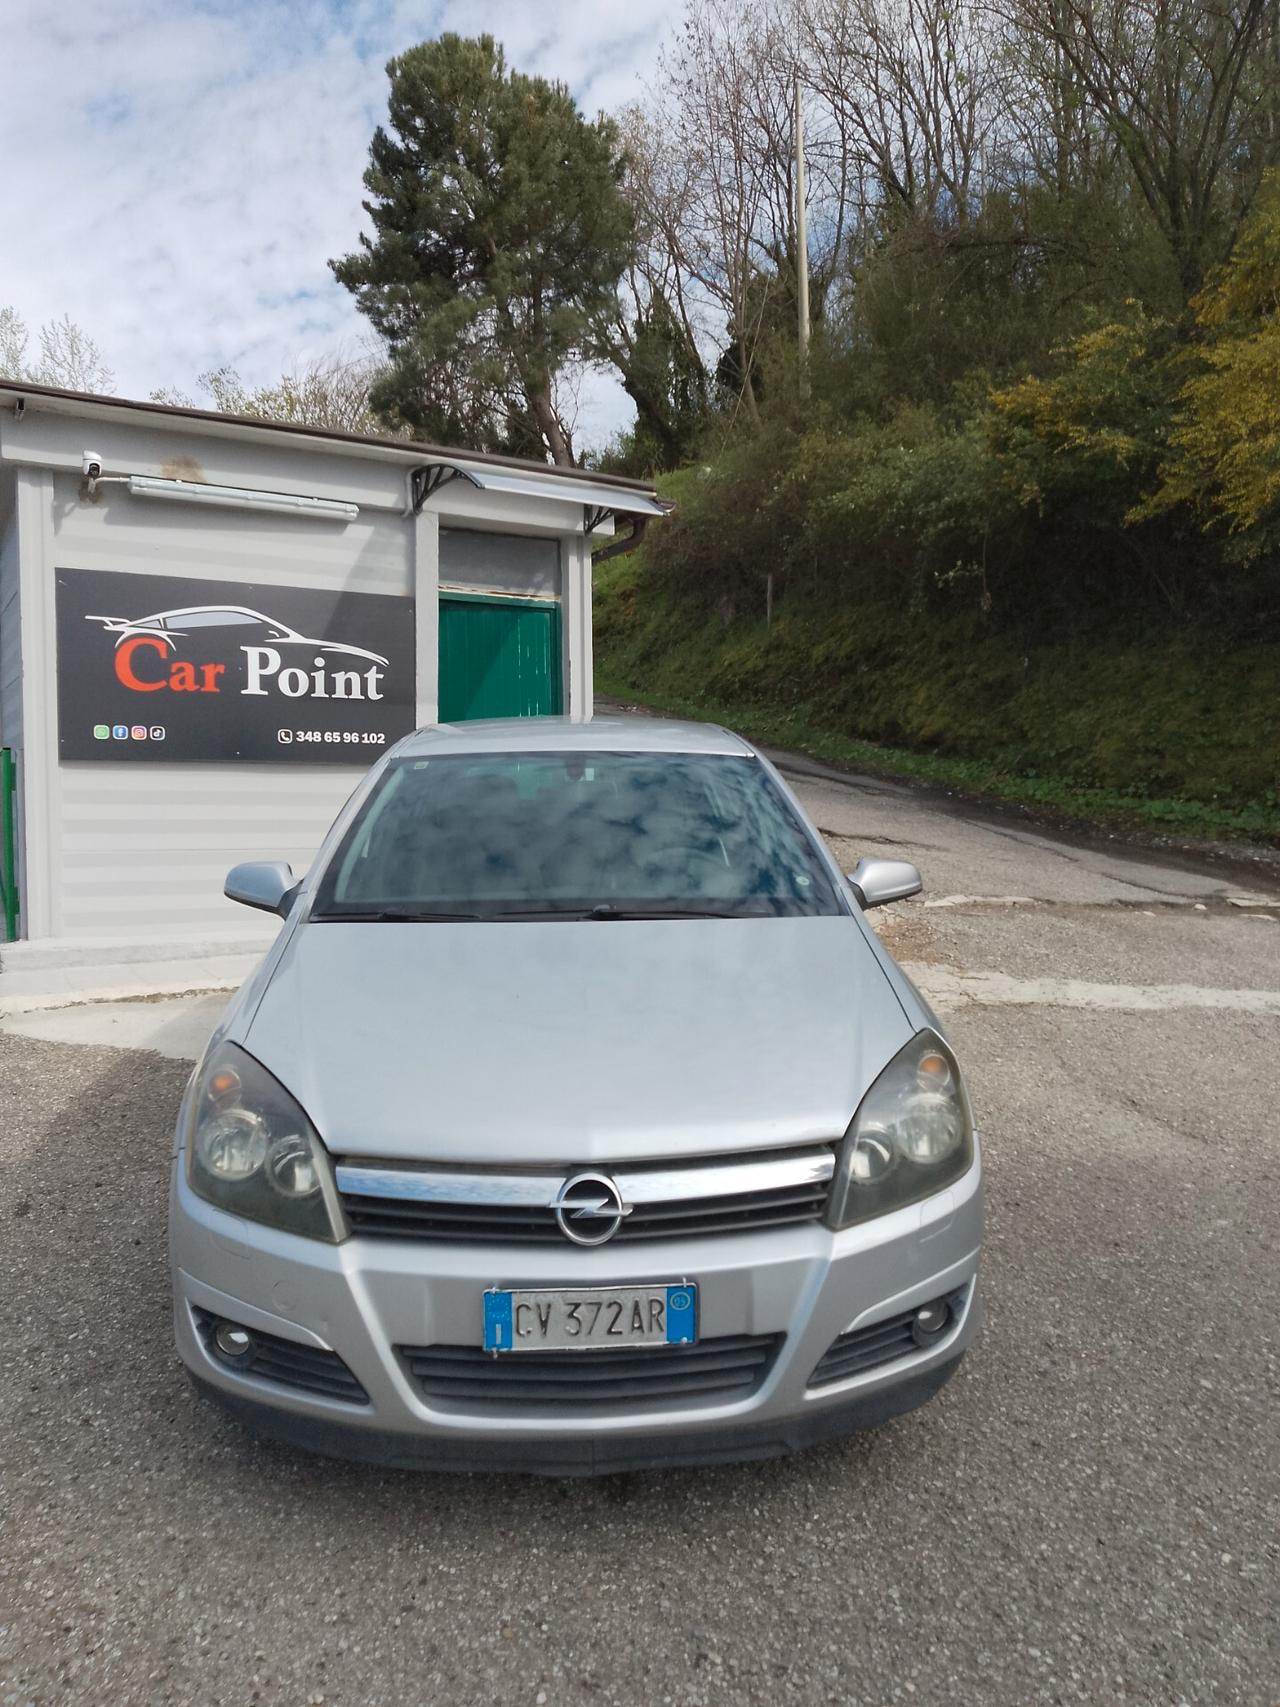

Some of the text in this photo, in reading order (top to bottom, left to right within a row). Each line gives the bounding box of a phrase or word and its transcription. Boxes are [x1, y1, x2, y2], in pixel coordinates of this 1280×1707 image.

[115, 638, 384, 701] Car Point
[296, 730, 386, 744] 348 65 96 102
[515, 1299, 665, 1338] CV 372AR
